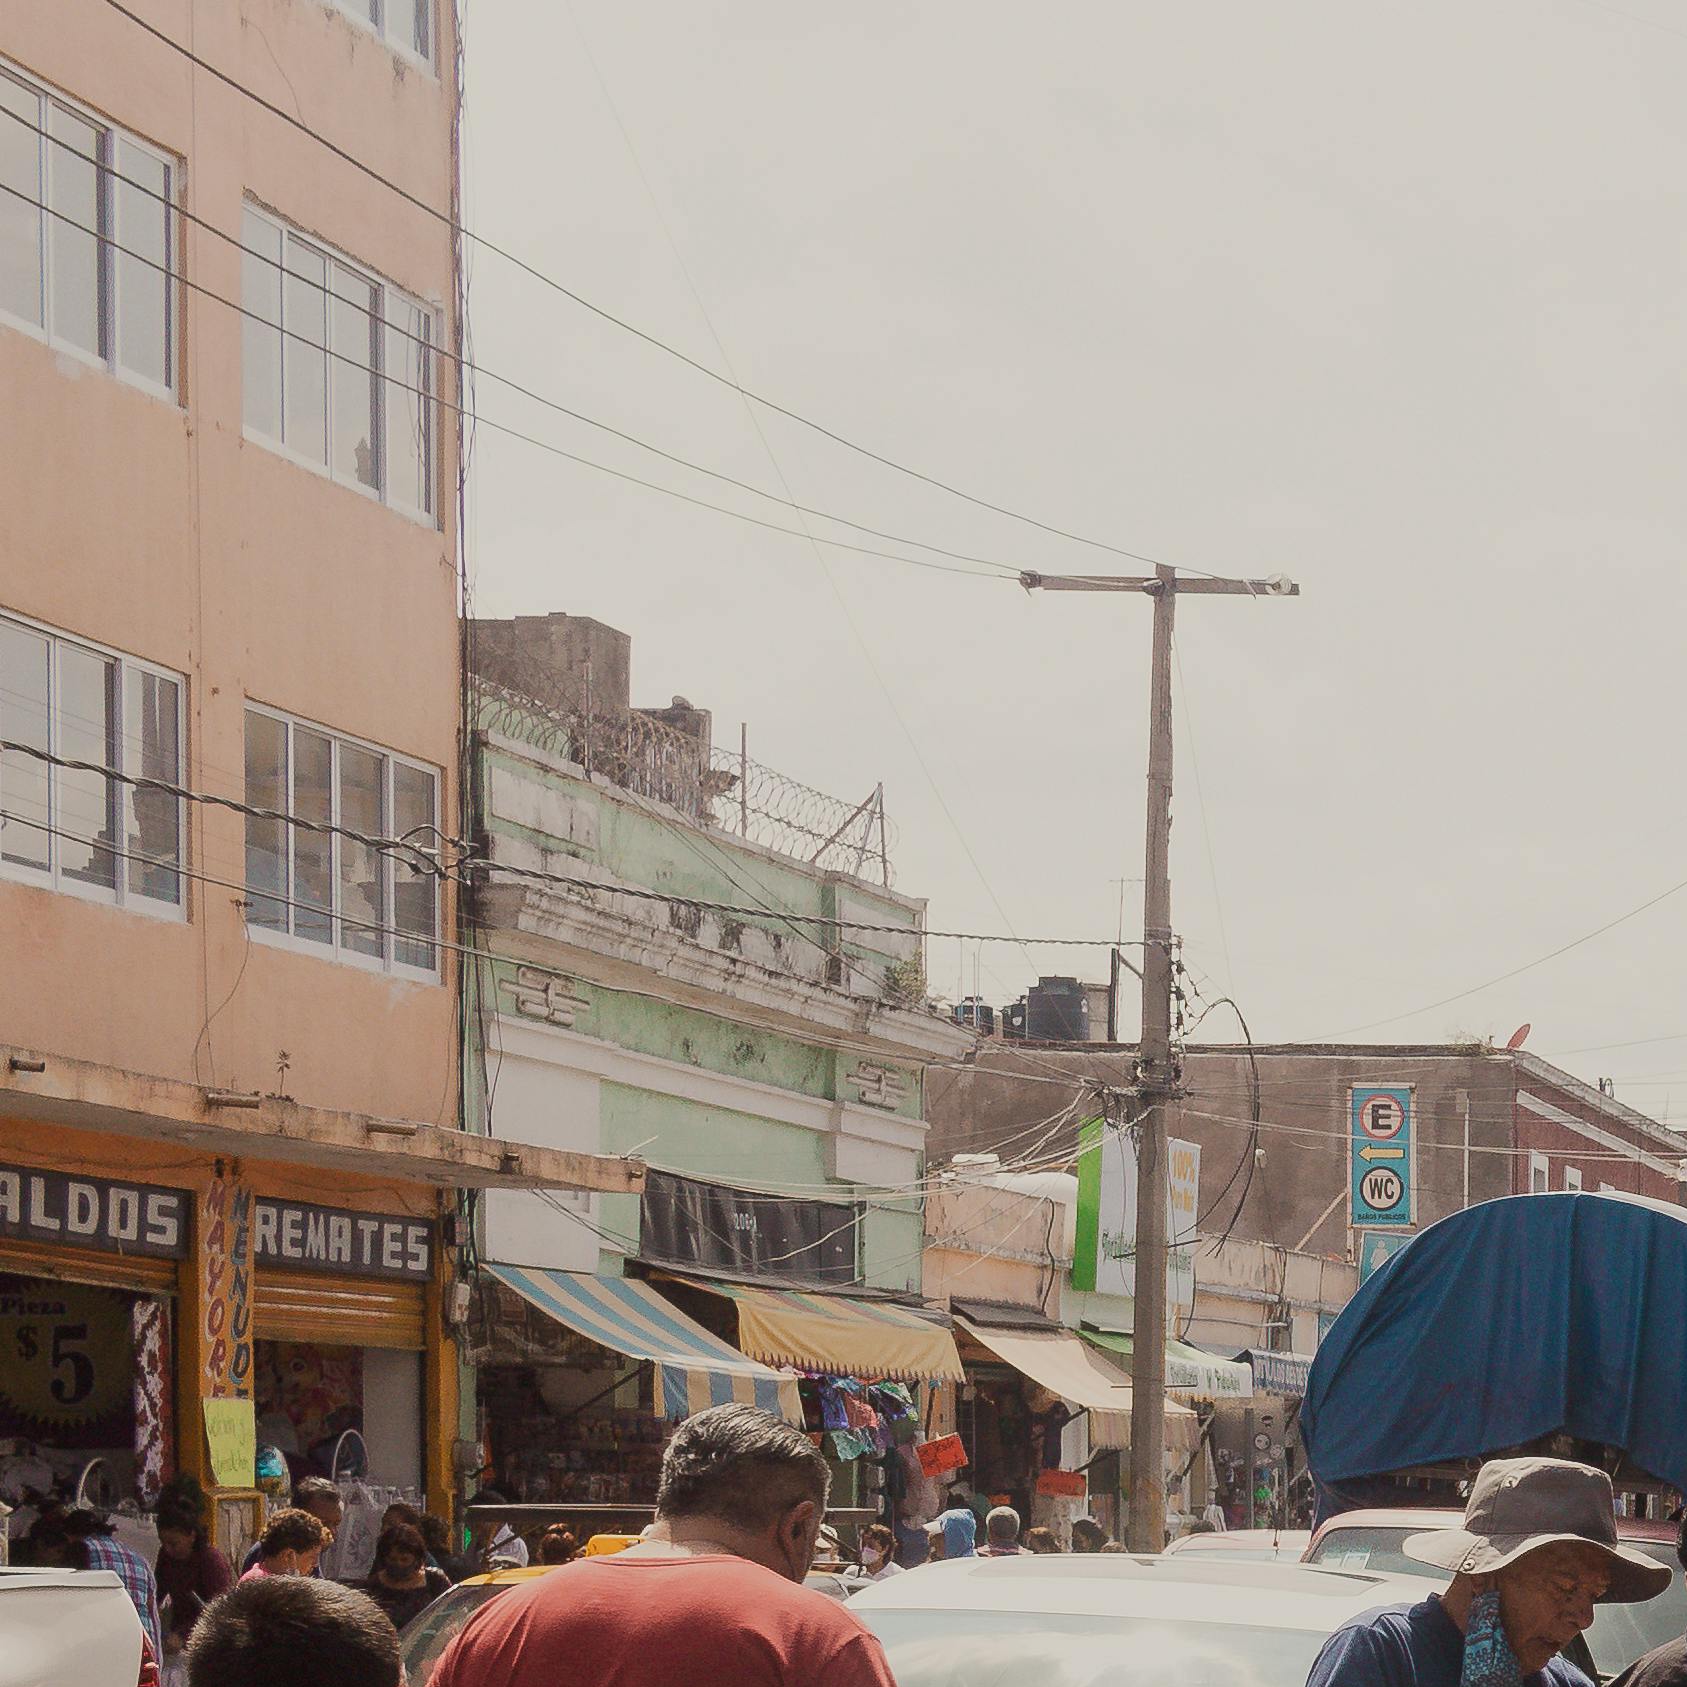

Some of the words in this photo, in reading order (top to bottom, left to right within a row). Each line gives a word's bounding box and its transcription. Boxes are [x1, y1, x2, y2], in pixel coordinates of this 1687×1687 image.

[0, 1170, 179, 1246] ALDOS
[1369, 1177, 1395, 1200] WC
[254, 1204, 429, 1272] REMATES
[2, 1300, 67, 1316] Pieza
[228, 1186, 252, 1399] MENUD
